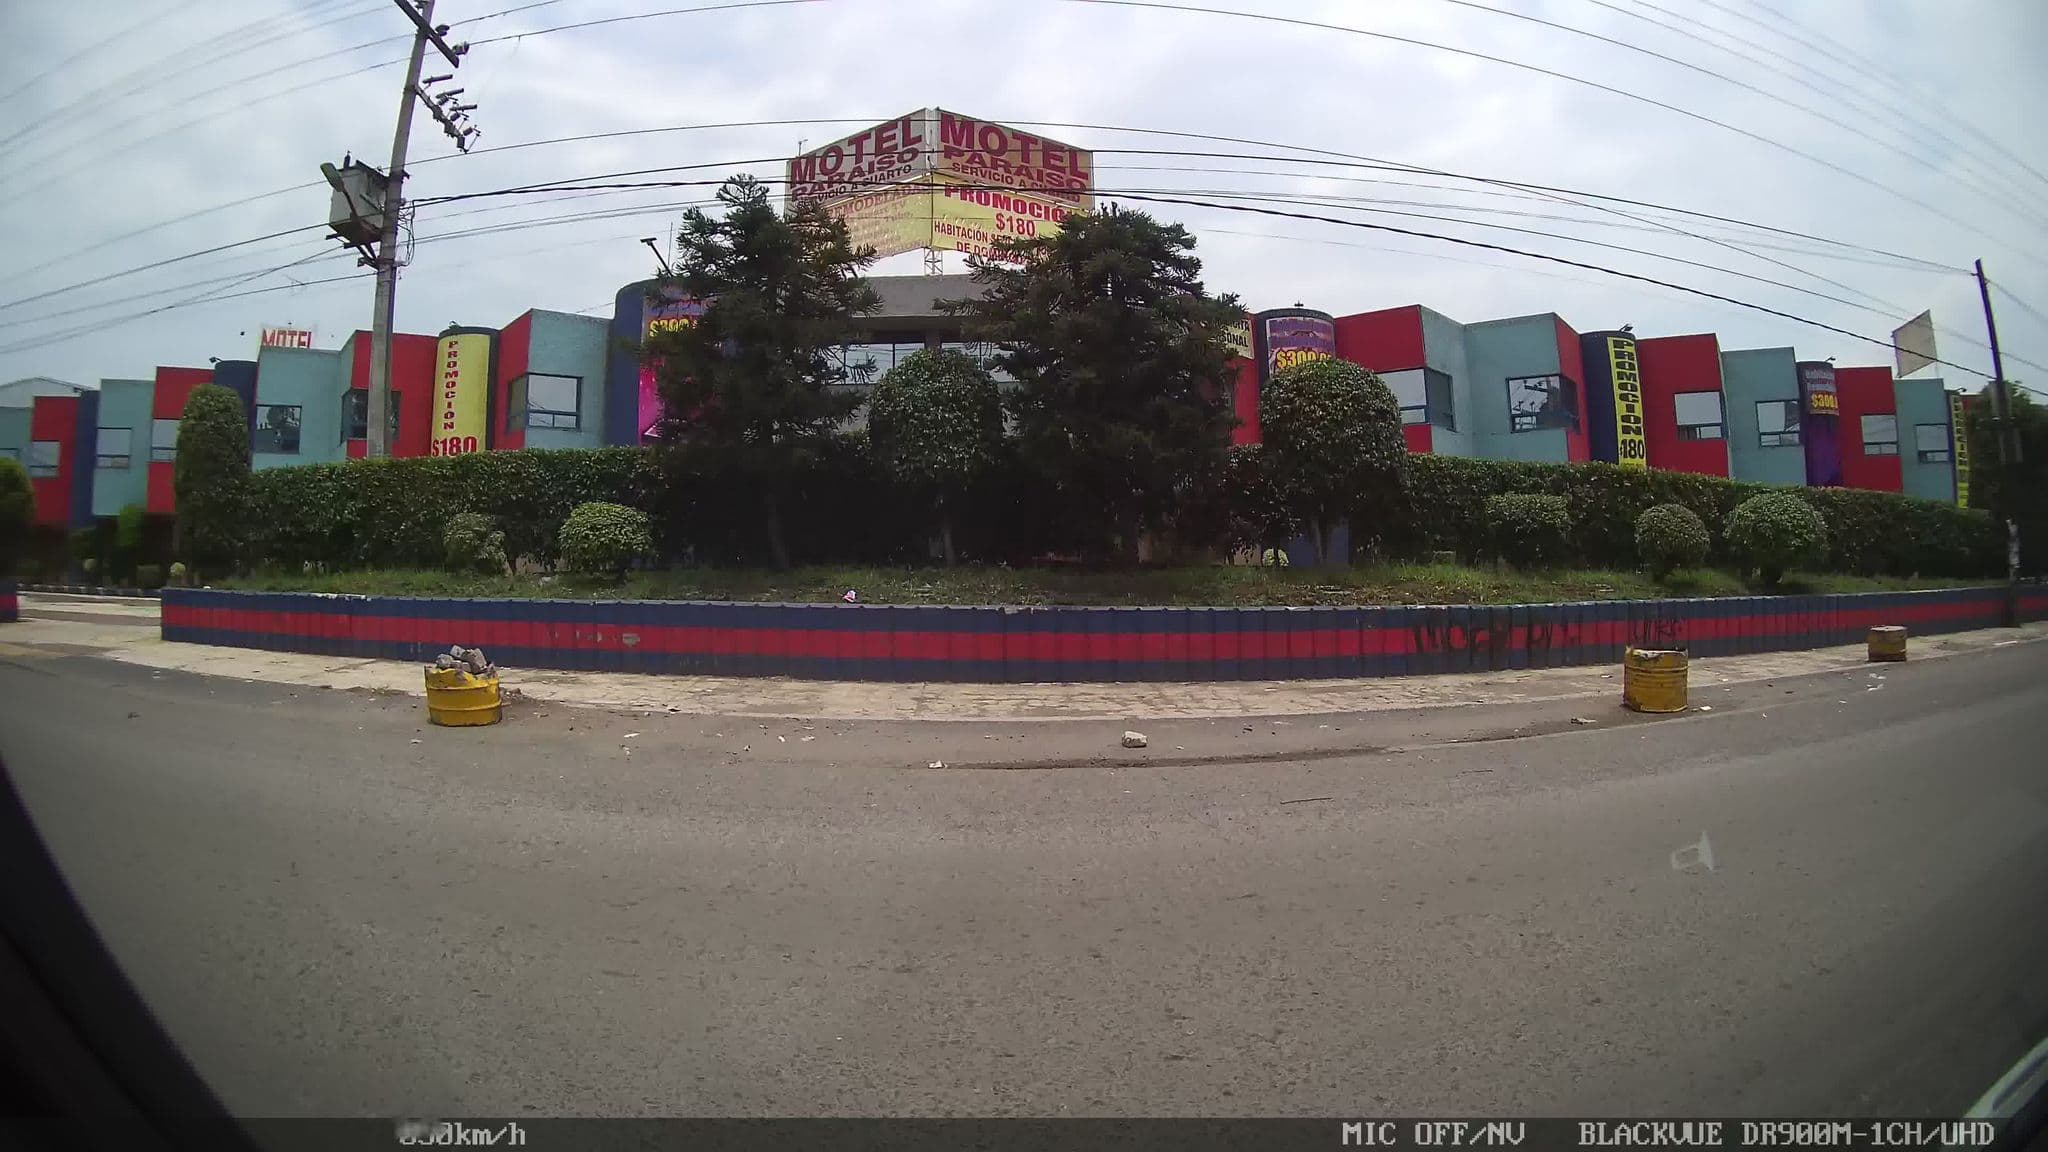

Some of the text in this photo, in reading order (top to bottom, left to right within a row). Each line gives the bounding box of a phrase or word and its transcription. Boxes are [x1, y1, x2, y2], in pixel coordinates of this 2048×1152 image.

[790, 117, 922, 188] MOTEL
[940, 112, 1089, 181] MOTEL
[791, 146, 920, 200] PARAISO
[944, 145, 1087, 193] PARAISO
[952, 162, 1027, 188] SERVICIO A
[944, 181, 1066, 224] PROMOCIO
[934, 220, 988, 244] HABITACIÓN
[995, 212, 1036, 238] $180
[956, 241, 971, 255] DE
[431, 436, 478, 457] $180
